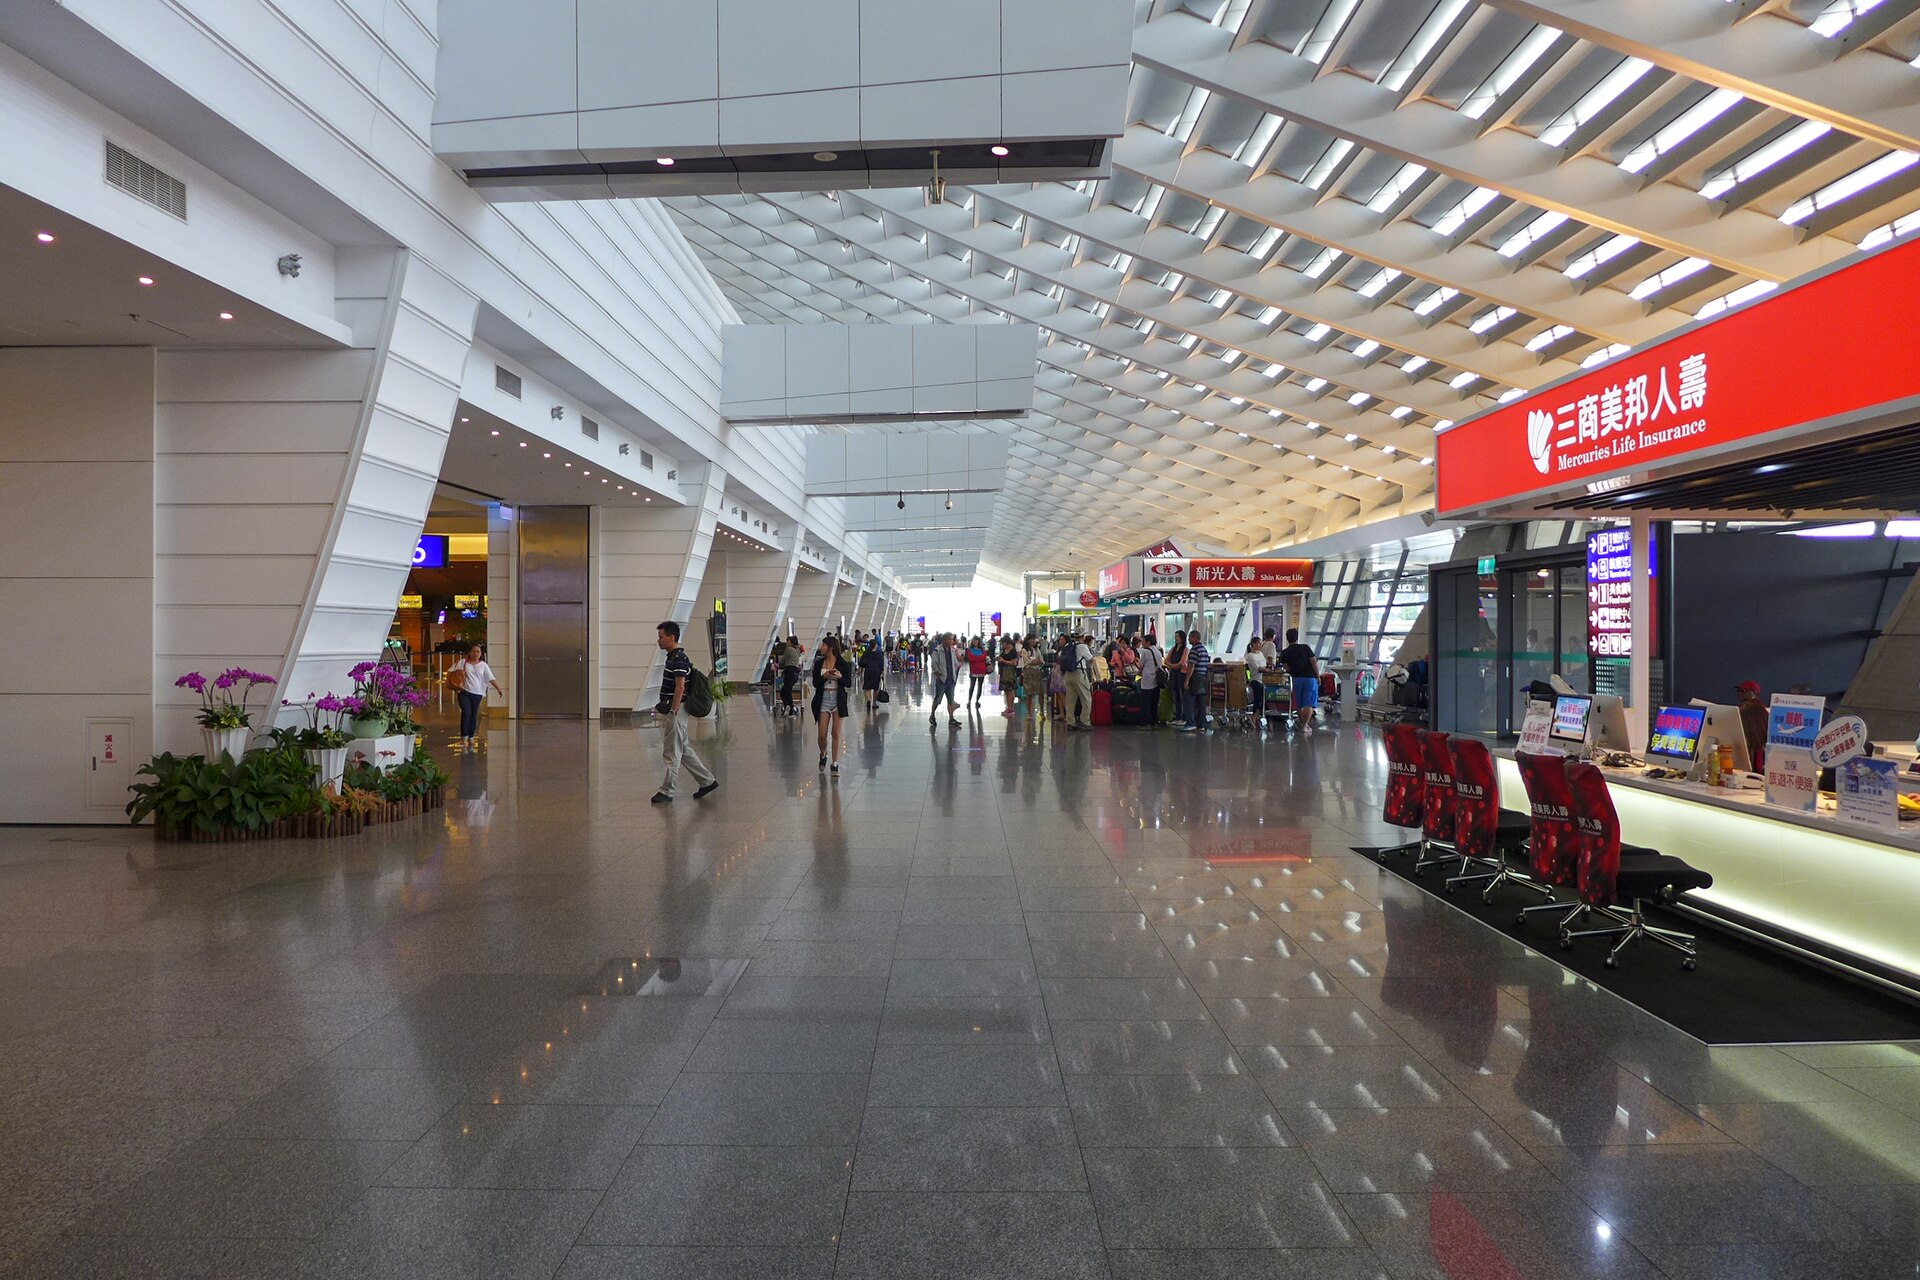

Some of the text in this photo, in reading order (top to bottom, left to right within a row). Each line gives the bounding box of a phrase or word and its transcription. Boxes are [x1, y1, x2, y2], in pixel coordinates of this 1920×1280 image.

[1557, 353, 1707, 448] 三商美邦人壽
[1558, 418, 1706, 471] Mercuries Life Insurance
[1195, 566, 1256, 581] 新光人壽
[1260, 573, 1274, 581] Shin
[1275, 574, 1291, 582] Kong
